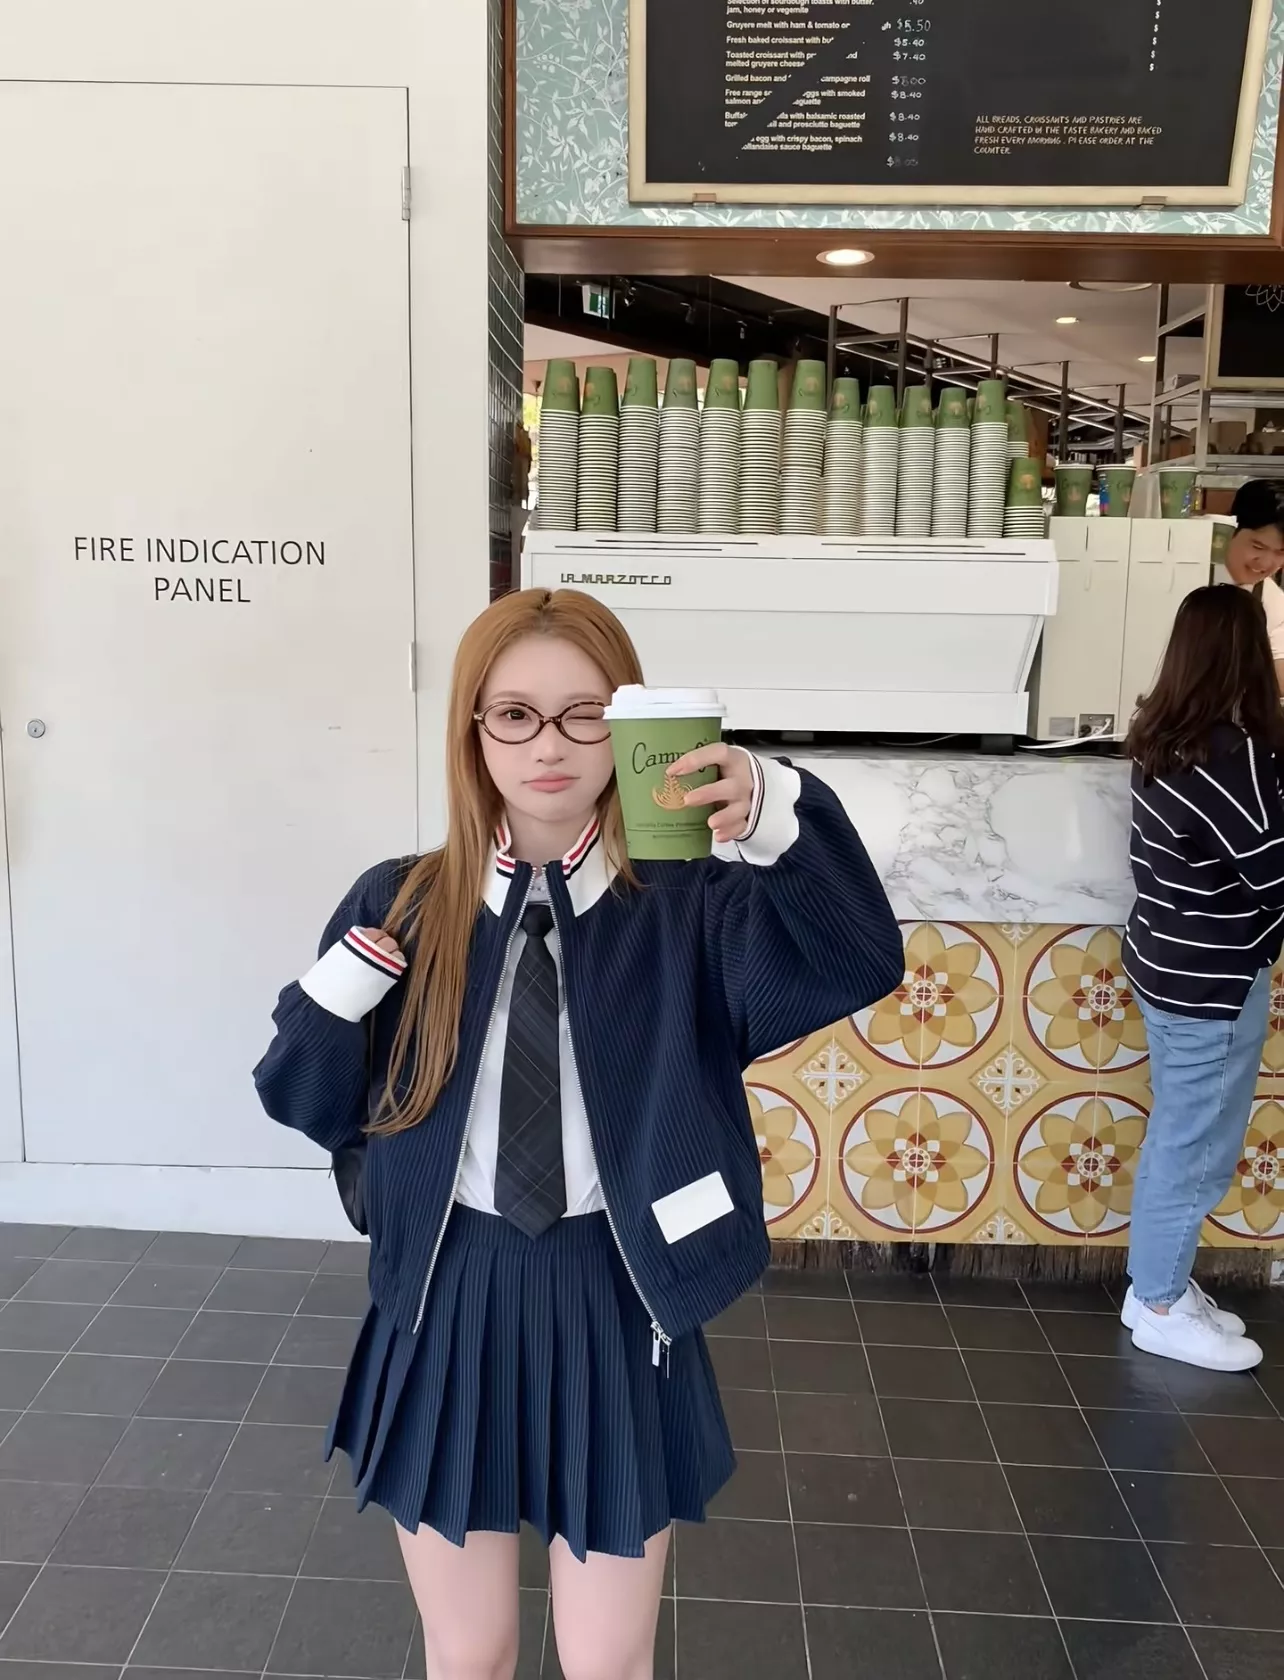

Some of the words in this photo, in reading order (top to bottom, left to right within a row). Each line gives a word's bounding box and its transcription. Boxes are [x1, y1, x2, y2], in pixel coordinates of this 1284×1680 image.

[744, 6, 766, 15] honey
[756, 21, 772, 29] melt
[773, 21, 789, 29] with
[790, 21, 806, 29] ham
[807, 21, 814, 29] &
[726, 36, 747, 44] Fresh
[748, 36, 770, 44] baked
[771, 36, 804, 44] croissant
[805, 36, 821, 44] with
[894, 37, 925, 47] $5.40
[726, 51, 755, 59] Toasted
[756, 51, 788, 59] croissant
[790, 51, 805, 59] with
[893, 51, 926, 61] $7.40
[726, 60, 750, 68] melted
[726, 74, 749, 82] Grilled
[750, 74, 772, 82] bacon
[774, 74, 787, 82] and
[725, 88, 741, 96] Free
[742, 90, 763, 98] range
[821, 89, 836, 97] with
[837, 89, 866, 97] smoked
[891, 90, 922, 99] $8.40
[725, 97, 751, 105] salmon
[789, 112, 805, 120] with
[806, 112, 836, 120] balsamic
[838, 112, 866, 120] roasted
[889, 112, 920, 121] $8.40
[976, 116, 990, 124] ALL
[1072, 116, 1087, 124] AND
[1128, 116, 1143, 124] ARE
[975, 126, 996, 134] HAND
[998, 126, 1034, 134] CRAFTED
[1035, 126, 1043, 134] IN
[1045, 126, 1060, 134] THE
[1063, 126, 1088, 134] TASTE
[1090, 126, 1118, 134] BAKERY
[1120, 126, 1135, 134] AND
[1137, 126, 1162, 134] BAKED
[756, 136, 770, 145] egg
[771, 135, 786, 143] with
[835, 135, 863, 144] spinach
[889, 132, 919, 142] $8.40
[974, 136, 1000, 144] FRESH
[1001, 136, 1026, 144] EVERY
[1099, 136, 1124, 144] ORDER
[1125, 136, 1136, 144] AT
[1139, 136, 1154, 144] THE
[74, 536, 134, 562] FIRE
[147, 538, 325, 565] INDICATION
[581, 573, 671, 585] MARZOCCO
[154, 577, 251, 603] PANEL
